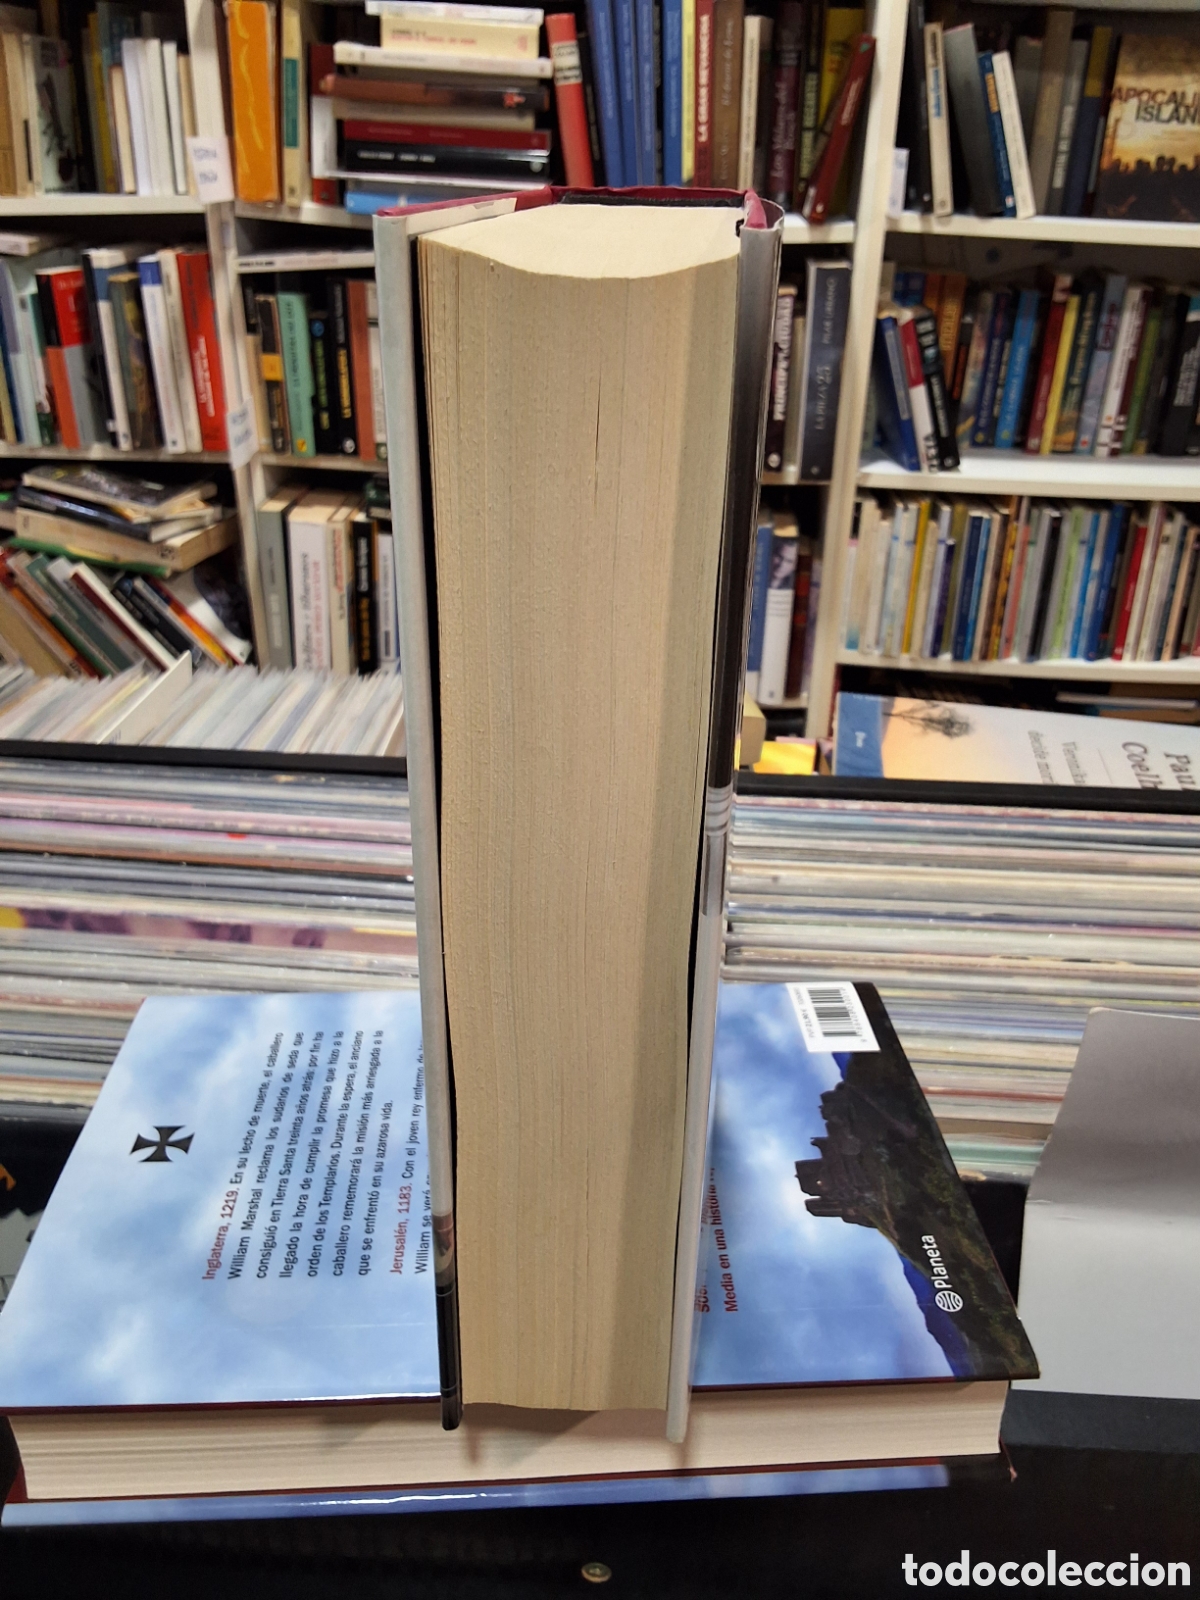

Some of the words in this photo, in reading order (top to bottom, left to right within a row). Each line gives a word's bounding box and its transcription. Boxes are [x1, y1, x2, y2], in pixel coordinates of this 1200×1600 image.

[698, 125, 708, 142] LA
[253, 1079, 272, 1112] muerte,
[342, 1071, 357, 1101] espera,
[272, 1086, 290, 1122] sudarios
[295, 1093, 309, 1114] años
[316, 1085, 332, 1122] promesa
[361, 1091, 373, 1109] más
[380, 1099, 393, 1120] vida.
[411, 1103, 424, 1116] rey
[246, 1115, 260, 1126] de
[265, 1126, 279, 1139] los
[287, 1116, 304, 1145] treinta
[311, 1126, 323, 1134] la
[330, 1113, 348, 1148] Durante
[355, 1113, 369, 1142] misión
[405, 1120, 420, 1144] joven
[238, 1129, 256, 1154] lecho
[351, 1146, 364, 1154] la
[376, 1122, 389, 1158] azarosa
[404, 1147, 416, 1155] el
[237, 1157, 248, 1168] su
[256, 1144, 275, 1183] reclama
[278, 1147, 296, 1175] Santa
[305, 1138, 322, 1173] cumplir
[374, 1161, 384, 1172] su
[229, 1171, 244, 1184] En
[318, 1151, 340, 1207] Templarios.
[371, 1175, 382, 1187] en
[401, 1160, 414, 1178] Con
[271, 1177, 289, 1207] Tierra
[298, 1177, 313, 1190] de
[343, 1158, 362, 1221] rememorará
[219, 1187, 240, 1218] 1219.
[240, 1188, 263, 1230] Marshal
[292, 1193, 309, 1217] hora
[396, 1182, 412, 1213] 1183.
[270, 1209, 282, 1222] en
[314, 1209, 329, 1224] los
[363, 1190, 380, 1234] enfrentó
[421, 1215, 431, 1227] se
[289, 1221, 303, 1231] la
[311, 1227, 326, 1241] de
[714, 1228, 727, 1250] una
[202, 1222, 232, 1279] Inglaterra,
[256, 1225, 278, 1278] consiguió
[279, 1236, 300, 1277] llegado
[332, 1224, 351, 1276] caballero
[362, 1237, 373, 1250] se
[389, 1218, 410, 1274] Jerusalén,
[414, 1231, 430, 1274] William
[227, 1236, 251, 1279] William
[306, 1244, 323, 1277] orden
[358, 1254, 372, 1275] que
[718, 1254, 731, 1269] en
[921, 1235, 952, 1288] Planeta
[720, 1273, 738, 1312] Media
